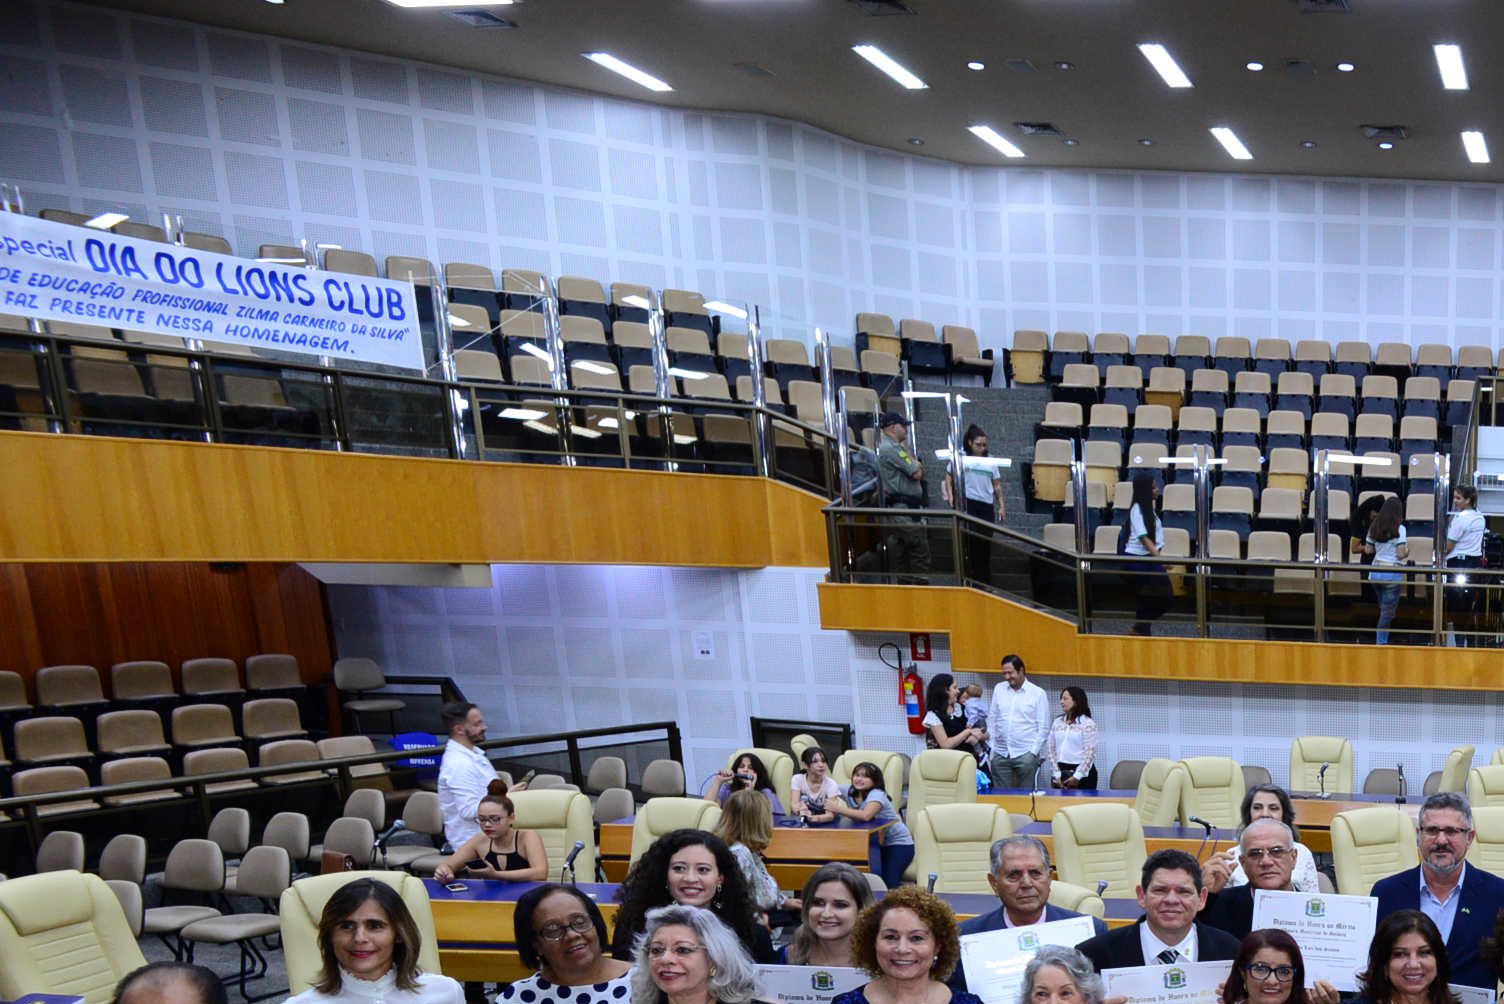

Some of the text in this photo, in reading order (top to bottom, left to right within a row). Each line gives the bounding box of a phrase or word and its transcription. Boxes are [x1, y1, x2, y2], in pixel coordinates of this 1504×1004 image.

[27, 273, 126, 300] EDUCAÇÃO
[131, 289, 228, 316] PROFISSIONAL
[236, 305, 279, 321] ZILMA
[282, 312, 346, 332] CARNEIRO
[350, 323, 366, 336] DA
[85, 238, 149, 280] DIA
[154, 251, 204, 289] DO
[215, 261, 315, 307] LIONS
[323, 278, 406, 321] CLUB
[5, 290, 356, 354] FAZ PRESENTE NESSA HOMENAGEM.
